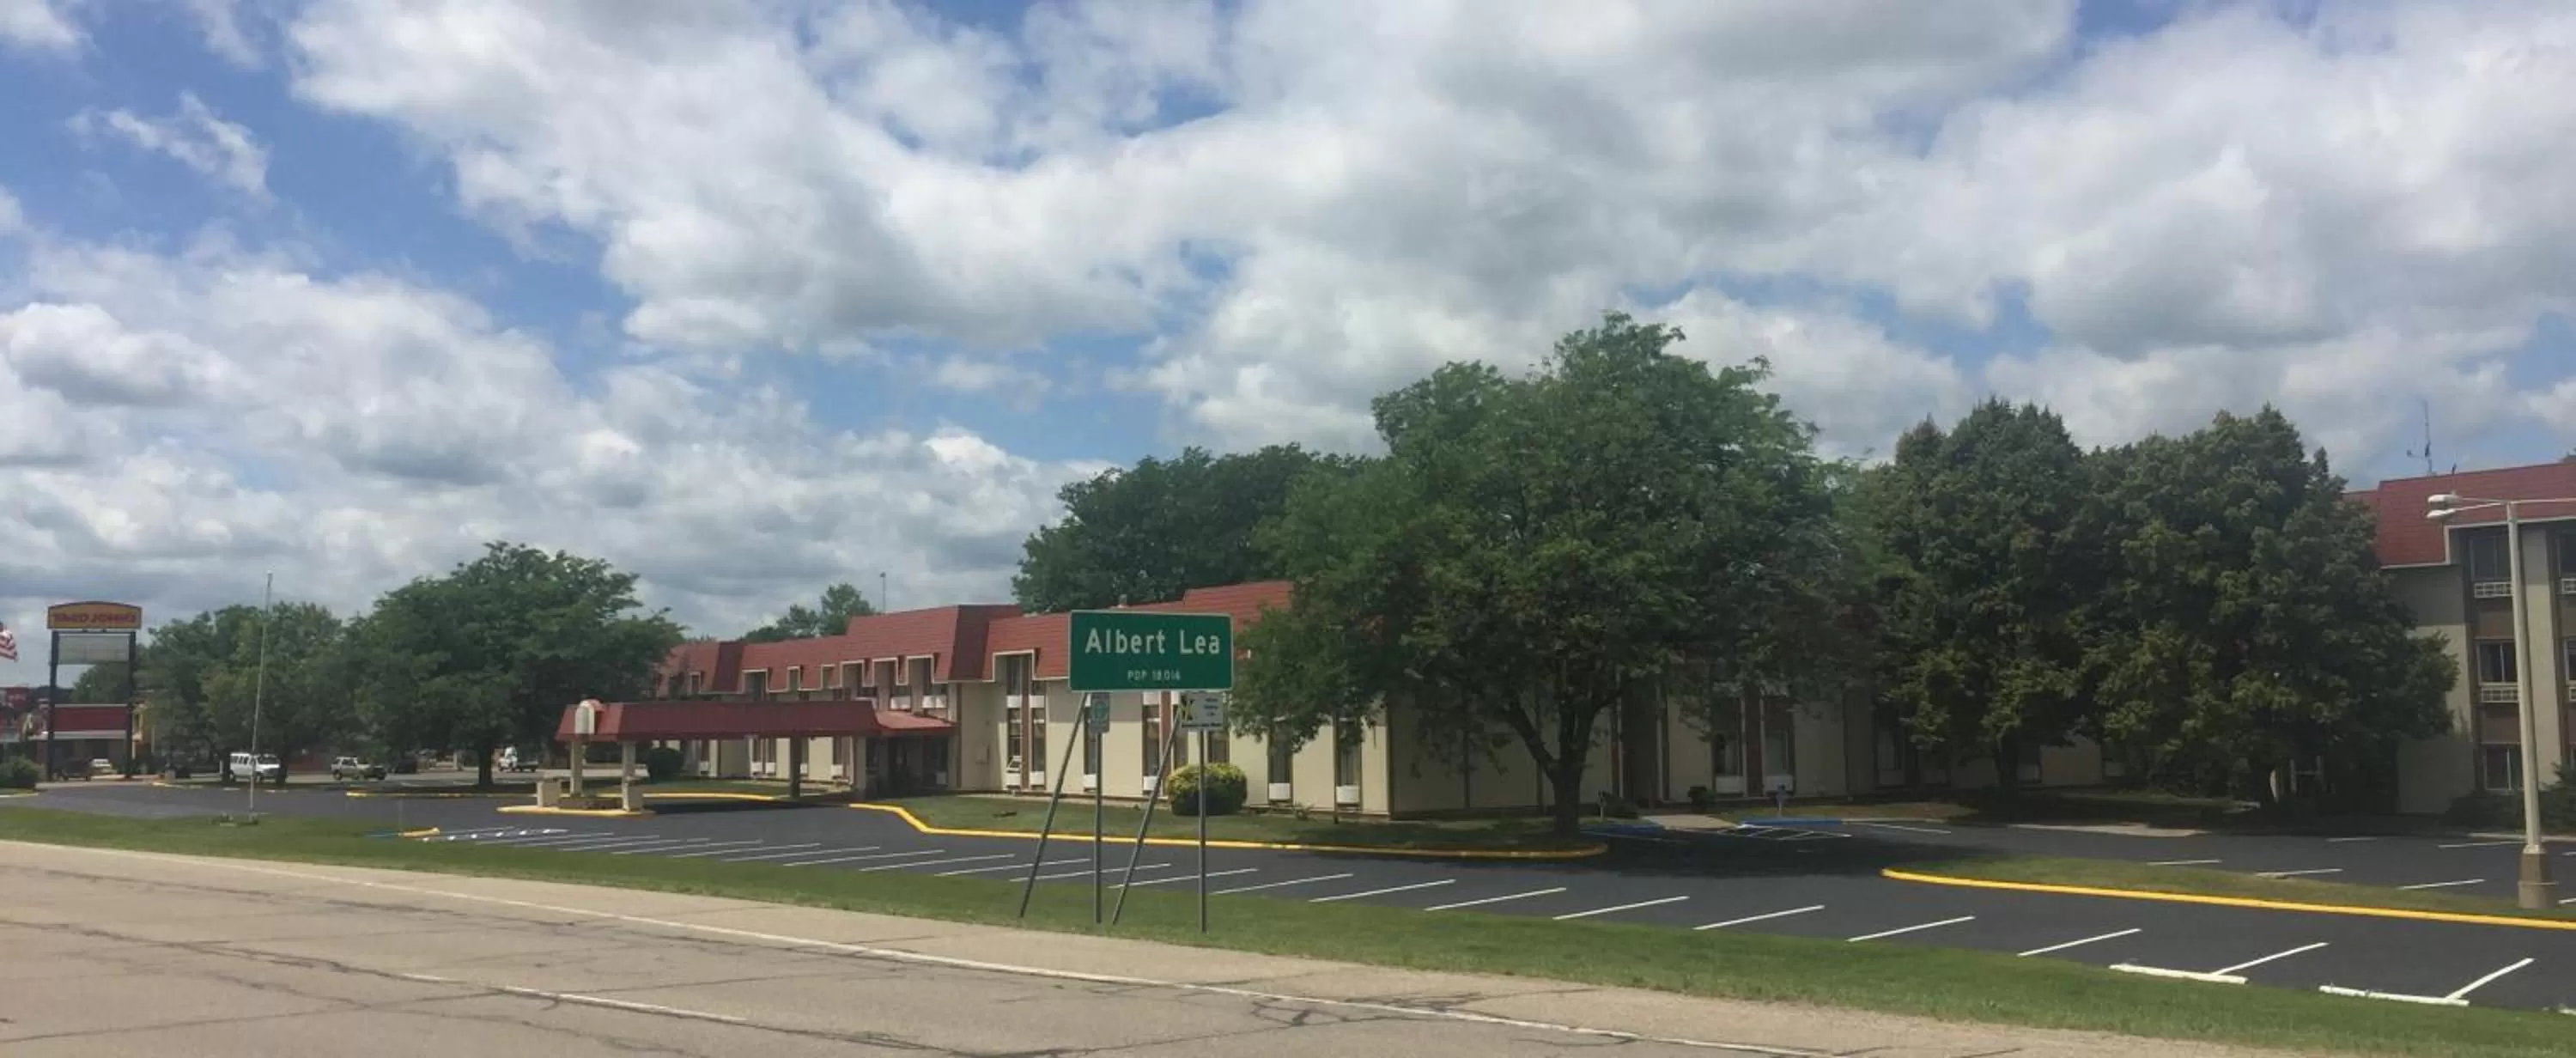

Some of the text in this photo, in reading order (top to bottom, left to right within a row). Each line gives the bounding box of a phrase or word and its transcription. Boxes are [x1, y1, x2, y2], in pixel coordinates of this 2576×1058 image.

[1084, 627, 1220, 654] Albert Lea
[1127, 669, 1148, 681] POP
